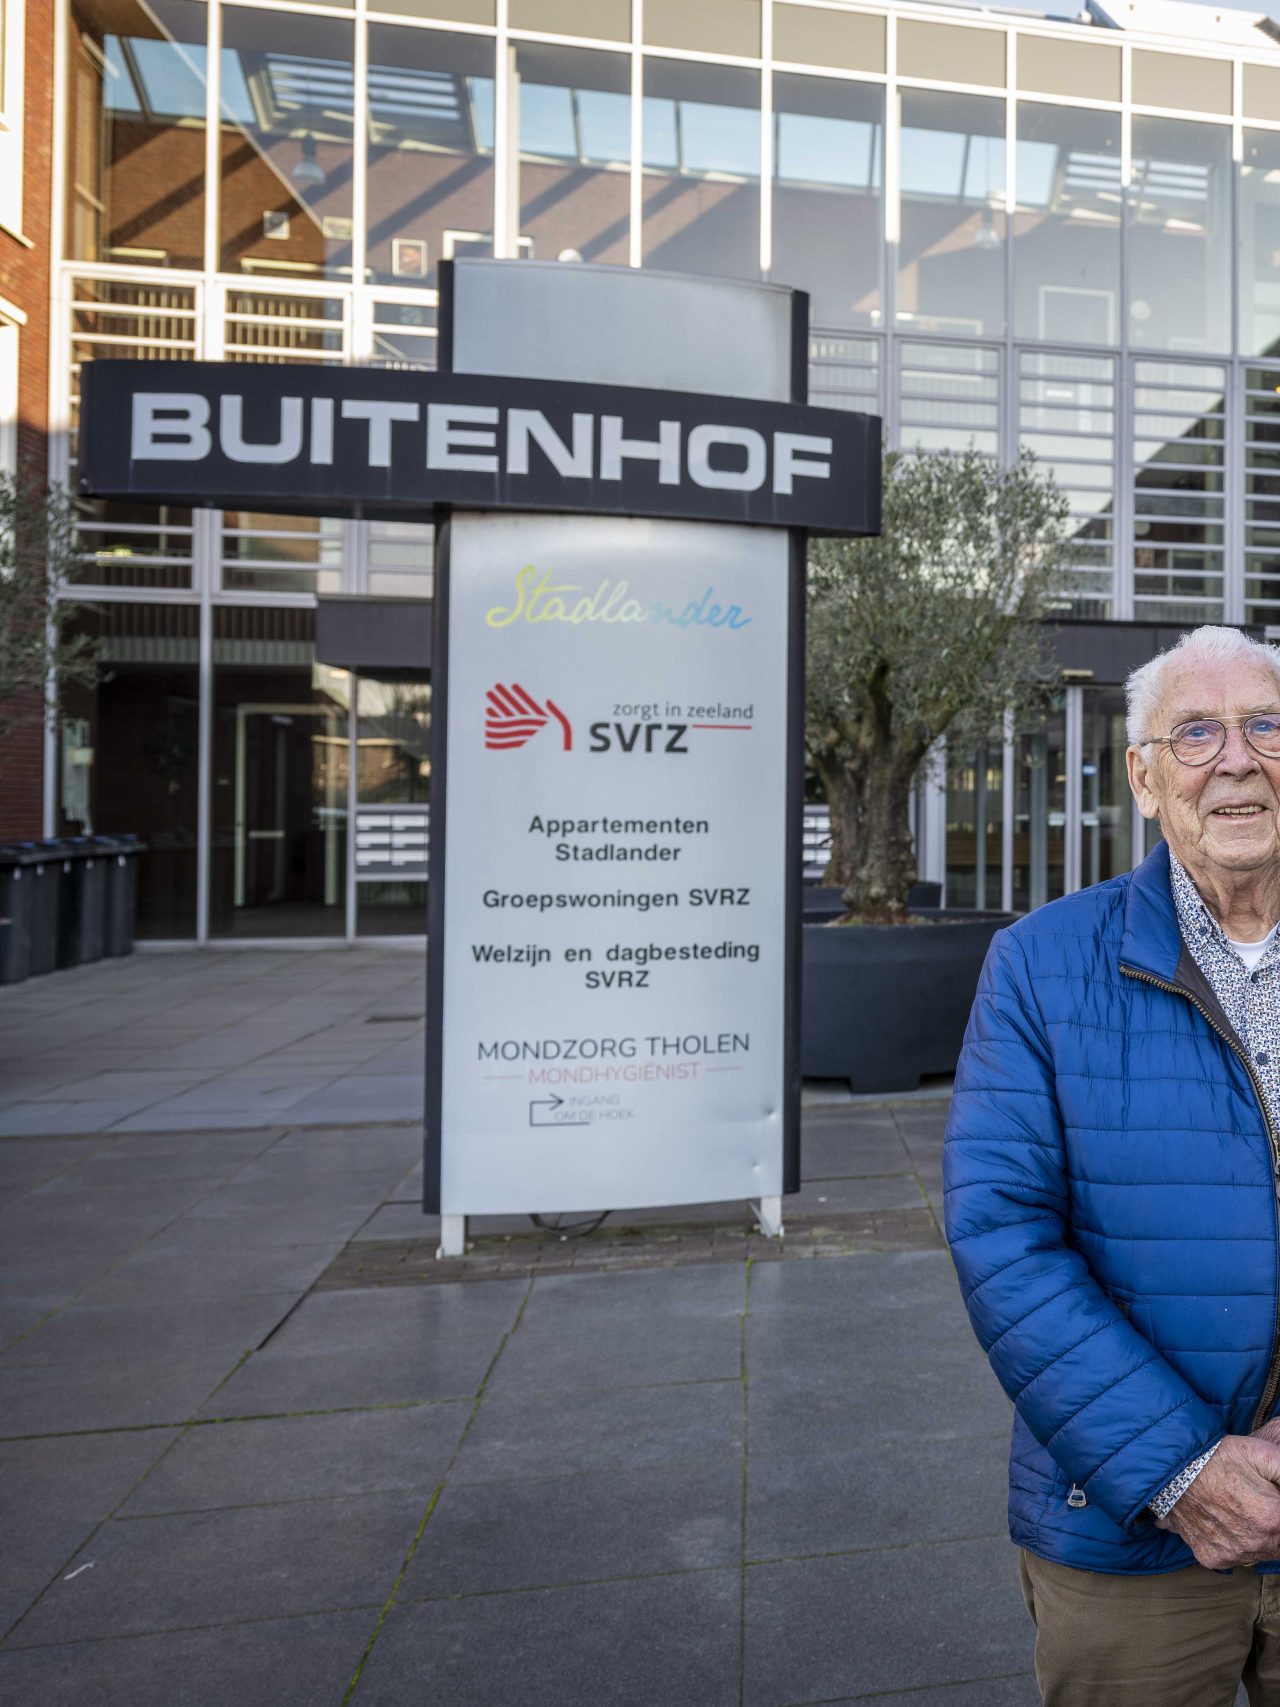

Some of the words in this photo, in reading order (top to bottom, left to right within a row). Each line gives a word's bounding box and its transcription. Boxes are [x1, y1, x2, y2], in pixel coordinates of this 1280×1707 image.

[130, 392, 833, 496] BUITENHOF
[485, 564, 753, 630] Stadlander
[613, 702, 659, 721] zorgt
[665, 702, 682, 717] in
[687, 703, 754, 720] zeeland
[528, 815, 709, 838] Appartementen
[555, 843, 681, 862] Stadlander
[482, 889, 679, 912] Groepswoningen
[688, 887, 751, 908] SVRZ
[471, 944, 551, 967] Welzijn
[564, 946, 592, 963] en
[606, 941, 761, 966] dagbesteding
[585, 970, 651, 989] SVRZ
[477, 1037, 637, 1062] MONDZORG
[645, 1033, 750, 1057] THOLEN
[568, 1093, 620, 1107] INGANG
[598, 1108, 635, 1121] HOEK
